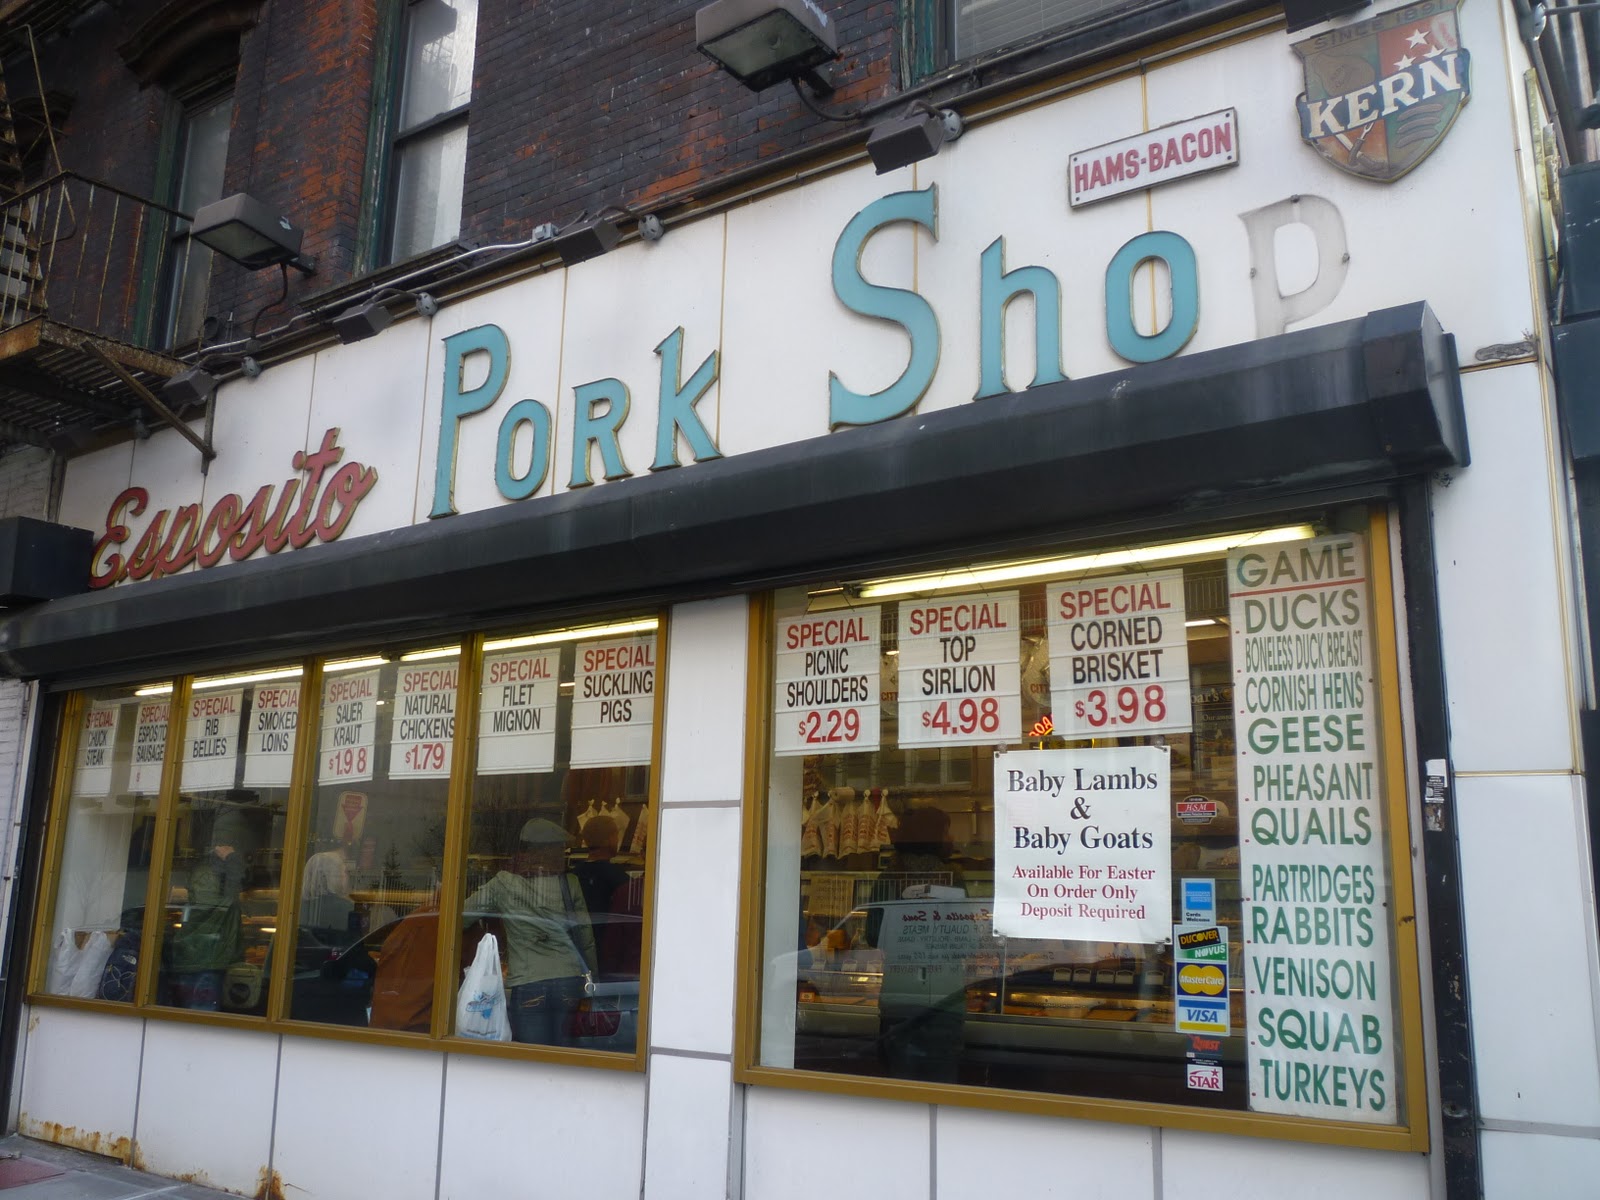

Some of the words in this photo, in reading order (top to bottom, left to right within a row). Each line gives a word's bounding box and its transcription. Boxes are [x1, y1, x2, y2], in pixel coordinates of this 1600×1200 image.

[1307, 52, 1461, 139] KERN
[1074, 122, 1232, 193] HAMS-BACON
[88, 427, 378, 589] Esposito
[1237, 542, 1356, 588] GAME
[1060, 582, 1171, 619] SPECIAL
[1244, 588, 1360, 634] DUCKS
[910, 603, 1007, 635] SPECIAL
[787, 617, 869, 650] SPECIAL
[1071, 616, 1162, 651] CORNED
[583, 645, 654, 672] SPECIAL
[805, 648, 849, 677] PICNIC
[939, 636, 976, 663] TOP
[1245, 635, 1293, 673] BONELESS
[1296, 632, 1325, 670] DUCK
[1327, 630, 1363, 668] BREAST
[490, 657, 550, 684] SPECIAL
[1073, 649, 1163, 684] BRISKET
[330, 678, 372, 703] SPECIAL
[403, 668, 458, 693] SPECIAL
[584, 671, 653, 698] SUCKLING
[787, 675, 868, 708] SHOULDERS
[922, 665, 995, 696] SIRLION
[1246, 673, 1317, 713] CORNISH
[1323, 670, 1364, 710] HENS
[193, 696, 235, 718] SPECIAL
[258, 690, 298, 709] SPECIA
[404, 693, 453, 716] NATURAL
[502, 684, 534, 707] FILET
[1075, 684, 1166, 727] $3.98
[86, 711, 114, 728] SPECIAL
[258, 711, 298, 731] SMOKED
[336, 702, 363, 724] SAUER
[493, 708, 541, 732] MIGNON
[600, 699, 632, 723] PIGS
[922, 697, 999, 736] $4.98
[88, 730, 108, 747] CHUCK
[138, 725, 167, 743] ESPOSITO
[205, 719, 218, 737] RIB
[333, 725, 362, 746] KRAUT
[400, 717, 455, 740] CHICKENS
[798, 708, 860, 744] $2.29
[1248, 713, 1365, 755] GEESE
[193, 738, 227, 758] BELLIES
[261, 733, 289, 752] LOINS
[86, 749, 104, 765] STEAK
[405, 743, 444, 770] $1.79
[1007, 769, 1065, 797] Baby
[1073, 767, 1158, 791] Lambs
[1253, 762, 1373, 801] PHEASANT
[1070, 796, 1091, 820] &
[1013, 826, 1071, 855] Baby
[1080, 825, 1153, 849] Goats
[1251, 807, 1372, 846] QUAILS
[1012, 865, 1074, 879] Available
[1078, 865, 1103, 880] For
[1107, 865, 1155, 880] Easter
[1252, 864, 1374, 905] PARTRIDGES
[1027, 883, 1049, 898] On
[1054, 884, 1097, 899] Order
[1102, 885, 1138, 903] Only
[1021, 903, 1073, 920] Deposit
[1078, 903, 1146, 921] Required
[1181, 930, 1218, 945] DISCOVER
[1252, 906, 1374, 948] RABBITS
[1195, 945, 1226, 958] NOVUS
[1180, 975, 1225, 986] MasterCard
[1252, 956, 1376, 1000] VENISON
[1187, 1009, 1218, 1023] VISA
[1258, 1007, 1382, 1055] SQUAB
[1189, 1075, 1220, 1089] STAR
[1259, 1059, 1385, 1112] TURKEYS
